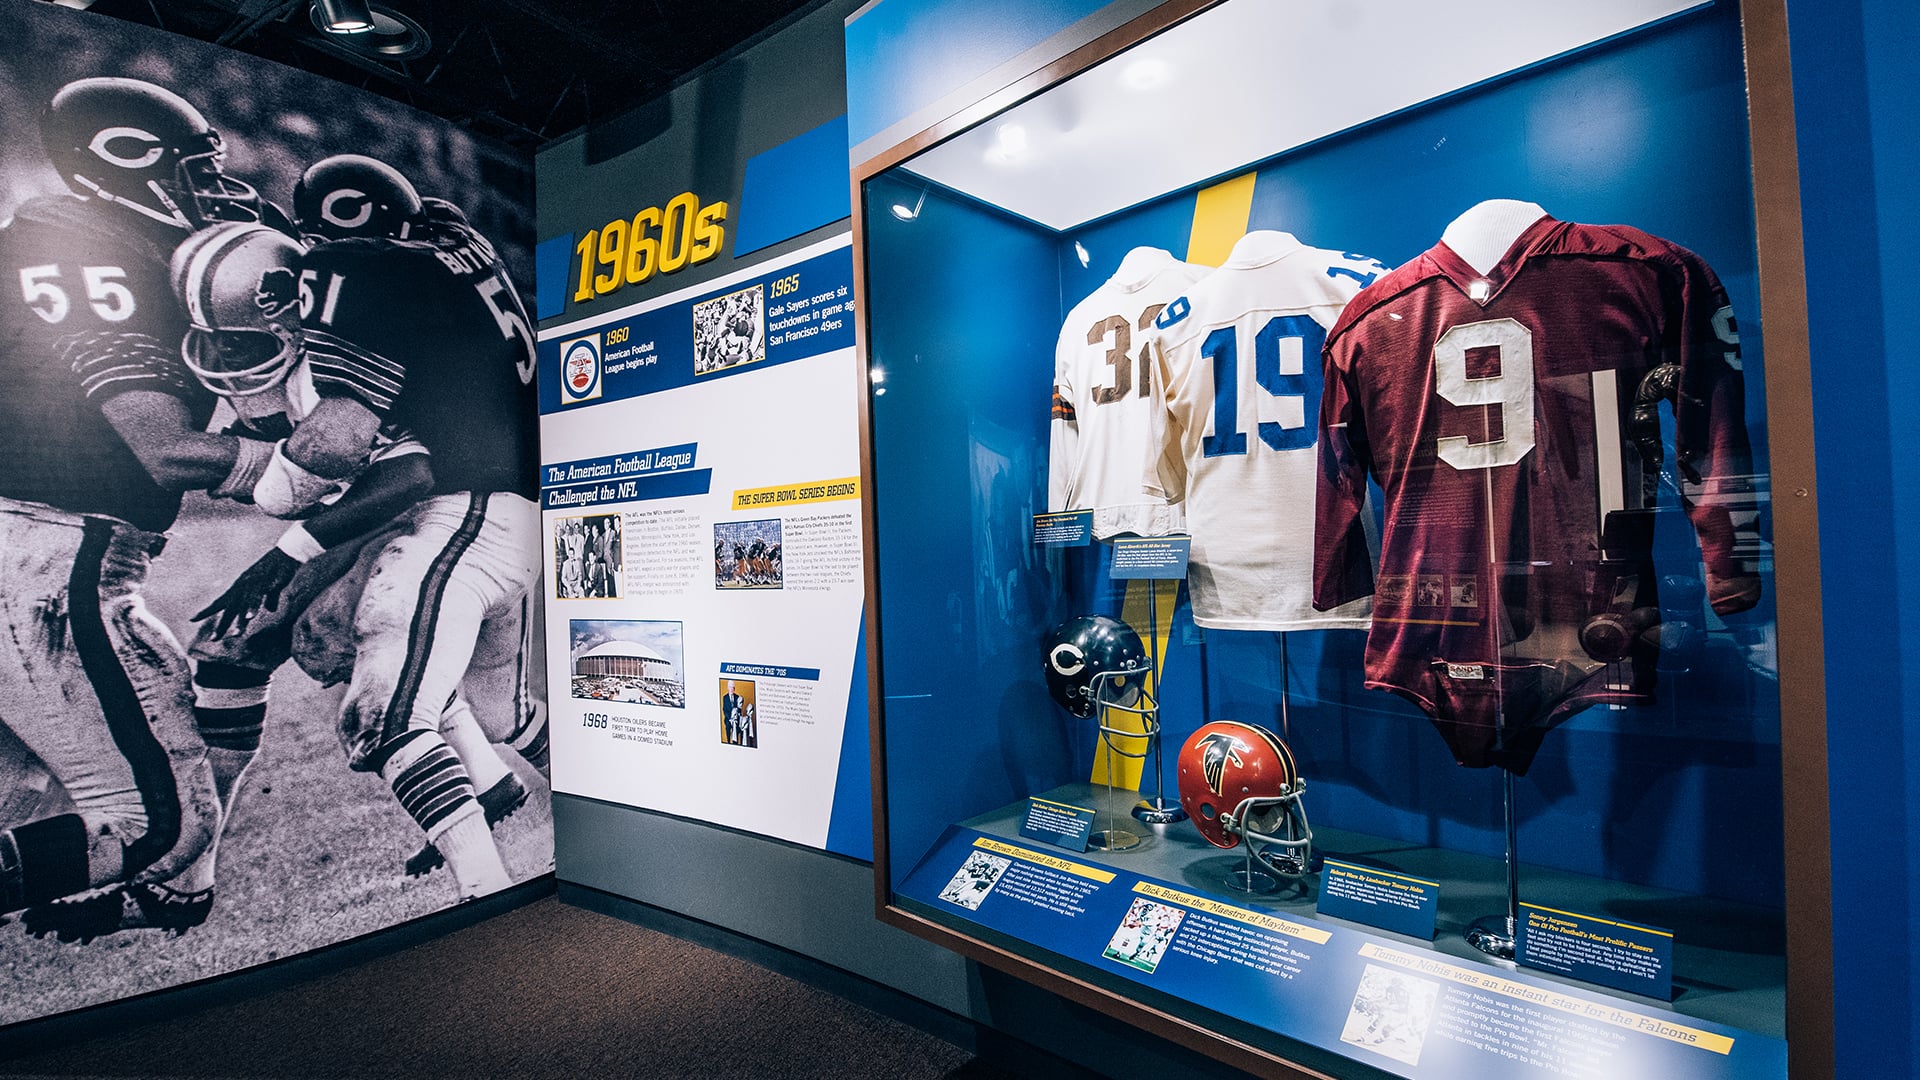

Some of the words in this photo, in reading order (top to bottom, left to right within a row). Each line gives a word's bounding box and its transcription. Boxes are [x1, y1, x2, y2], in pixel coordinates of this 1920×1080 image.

[574, 191, 727, 302] 1960s
[20, 265, 136, 323] 55
[299, 269, 346, 324] 51
[770, 274, 799, 299] 1965
[769, 304, 784, 317] Gale
[787, 299, 809, 313] Sayers
[812, 292, 835, 306] scores
[837, 286, 848, 299] six
[770, 313, 810, 332] touchdowns
[813, 309, 820, 320] in
[822, 304, 842, 320] game
[770, 335, 782, 345] San
[786, 325, 818, 341] Francisco
[820, 319, 842, 332] 49ers
[605, 326, 630, 346] 1960
[605, 349, 630, 361] American
[632, 341, 654, 355] Football
[605, 363, 625, 374] League
[626, 357, 643, 370] begins
[644, 354, 658, 367] play
[1201, 314, 1327, 458] 19
[1435, 318, 1537, 470] 9
[549, 467, 564, 482] The
[567, 462, 611, 480] American
[614, 454, 652, 474] Football
[654, 452, 691, 470] League
[549, 486, 597, 505] Challenged
[601, 485, 614, 500] the
[618, 482, 637, 498] NFL
[738, 495, 750, 505] THE
[753, 492, 774, 503] SUPER
[776, 490, 797, 501] BOWL
[799, 487, 825, 499] SERIES
[827, 483, 855, 496] BEGINS
[736, 666, 764, 674] DOMINATES
[583, 713, 608, 729] 1968
[648, 720, 666, 728] BECAME
[655, 729, 668, 737] HOME
[654, 738, 672, 746] STADIUM
[981, 840, 991, 848] Jim
[992, 843, 1011, 854] Brown
[1012, 848, 1045, 863] Dominated
[1046, 857, 1056, 866] the
[1056, 860, 1072, 870] NFL
[1330, 869, 1346, 877] Helmet
[1366, 876, 1391, 886] Linebacker
[1392, 882, 1409, 891] Tommy
[1410, 885, 1424, 893] Nobis
[1142, 884, 1160, 895] Dick
[1161, 889, 1190, 904] Butkus
[1191, 897, 1205, 908] the
[1248, 913, 1257, 922] of
[1201, 916, 1218, 925] Butkus
[1219, 922, 1240, 931] wreaked
[1240, 926, 1255, 935] havoc
[1264, 934, 1289, 945] opposing
[1529, 913, 1548, 923] Sonny
[1183, 926, 1200, 935] racked
[1212, 933, 1240, 947] then-record
[1250, 945, 1269, 955] fumble
[1270, 952, 1297, 964] recoveries
[1186, 920, 1207, 930] offenses.
[1213, 927, 1243, 941] hard-hitting
[1244, 936, 1271, 948] instinctive
[1271, 944, 1289, 954] player,
[1290, 949, 1310, 960] Butkus
[1528, 920, 1540, 928] One
[1560, 927, 1588, 938] Football's
[1589, 933, 1604, 942] Most
[1605, 937, 1627, 947] Prolific
[1628, 942, 1653, 952] Passers
[1198, 937, 1230, 951] interceptions
[1230, 947, 1247, 958] during
[1258, 956, 1283, 967] nine-year
[1283, 964, 1300, 973] career
[1534, 942, 1558, 951] something
[1604, 956, 1621, 965] they're
[1622, 960, 1646, 972] defeating
[1373, 948, 1414, 968] Tommy
[1416, 959, 1450, 976] Nobis
[1454, 971, 1478, 983] was
[1482, 979, 1497, 988] an
[1502, 982, 1548, 1002] instant
[1552, 997, 1580, 1011] star
[1584, 1003, 1606, 1018] for
[1610, 1010, 1633, 1025] the
[1637, 1017, 1697, 1042] Falcons
[1448, 987, 1471, 1000] Tommy
[1473, 994, 1494, 1005] Nobis
[1495, 1001, 1510, 1009] was
[1511, 1004, 1524, 1013] the
[1526, 1008, 1540, 1018] first
[1543, 1014, 1566, 1025] player
